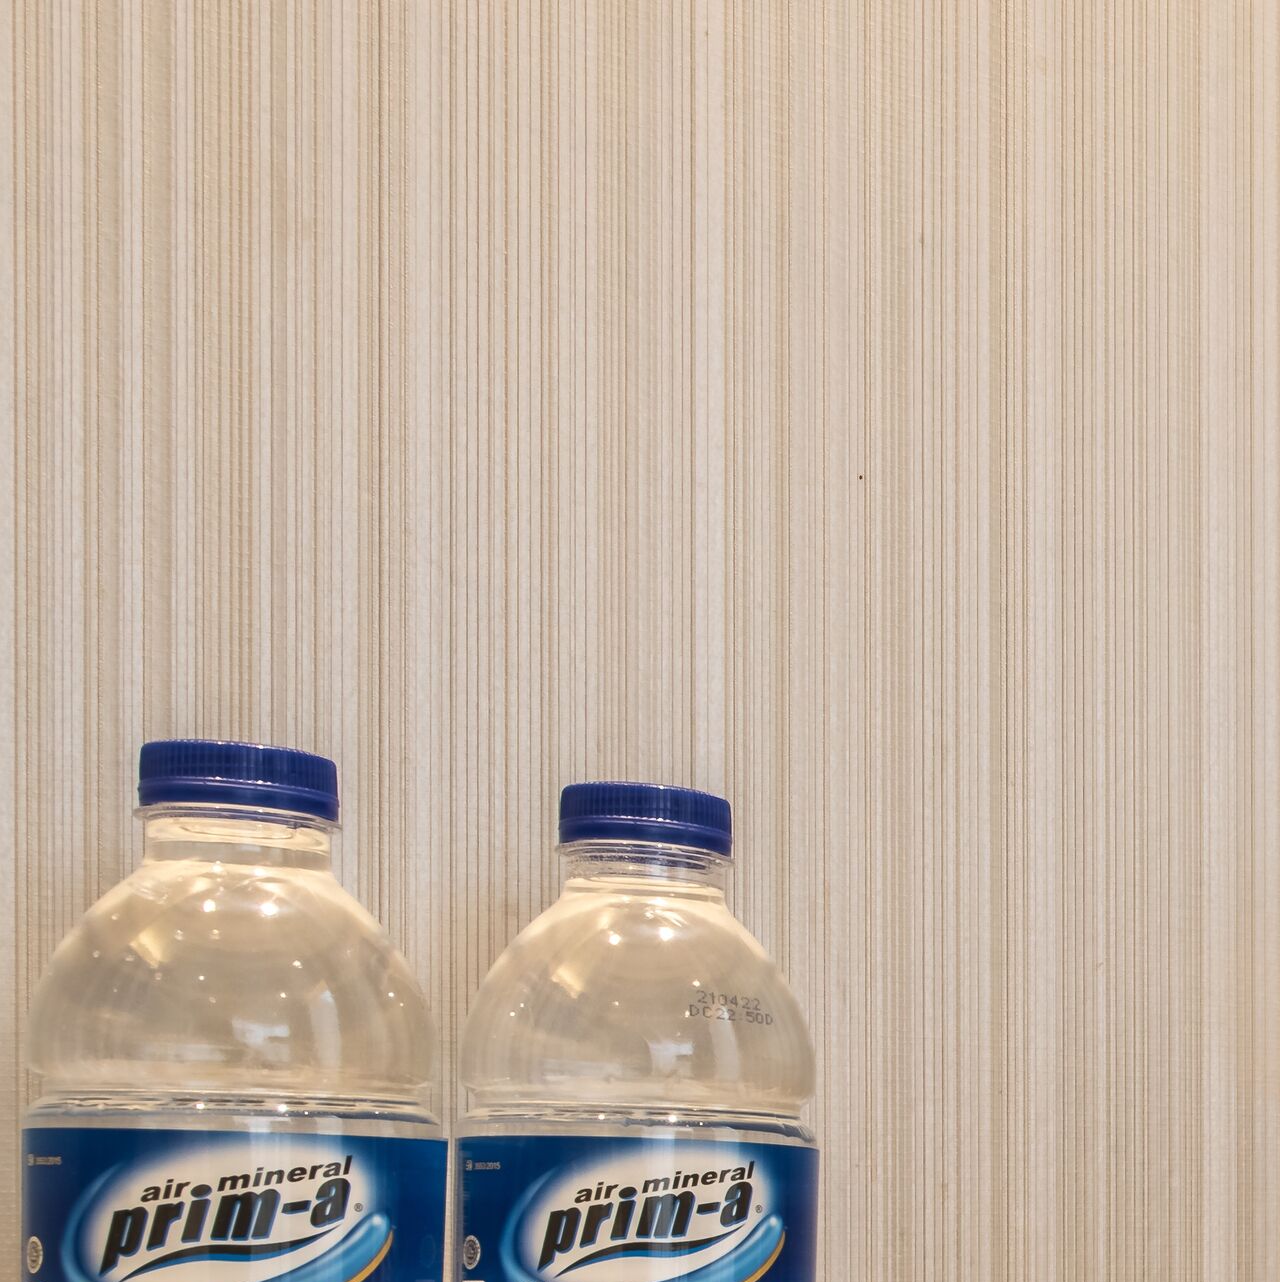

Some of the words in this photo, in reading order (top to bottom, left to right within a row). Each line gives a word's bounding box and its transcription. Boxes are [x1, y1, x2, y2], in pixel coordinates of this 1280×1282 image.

[141, 1178, 189, 1202] air
[217, 1155, 354, 1193] mineral
[574, 1180, 618, 1204] air
[641, 1160, 756, 1196] mineral
[99, 1178, 353, 1277] prim-a
[536, 1181, 753, 1271] prim-a
